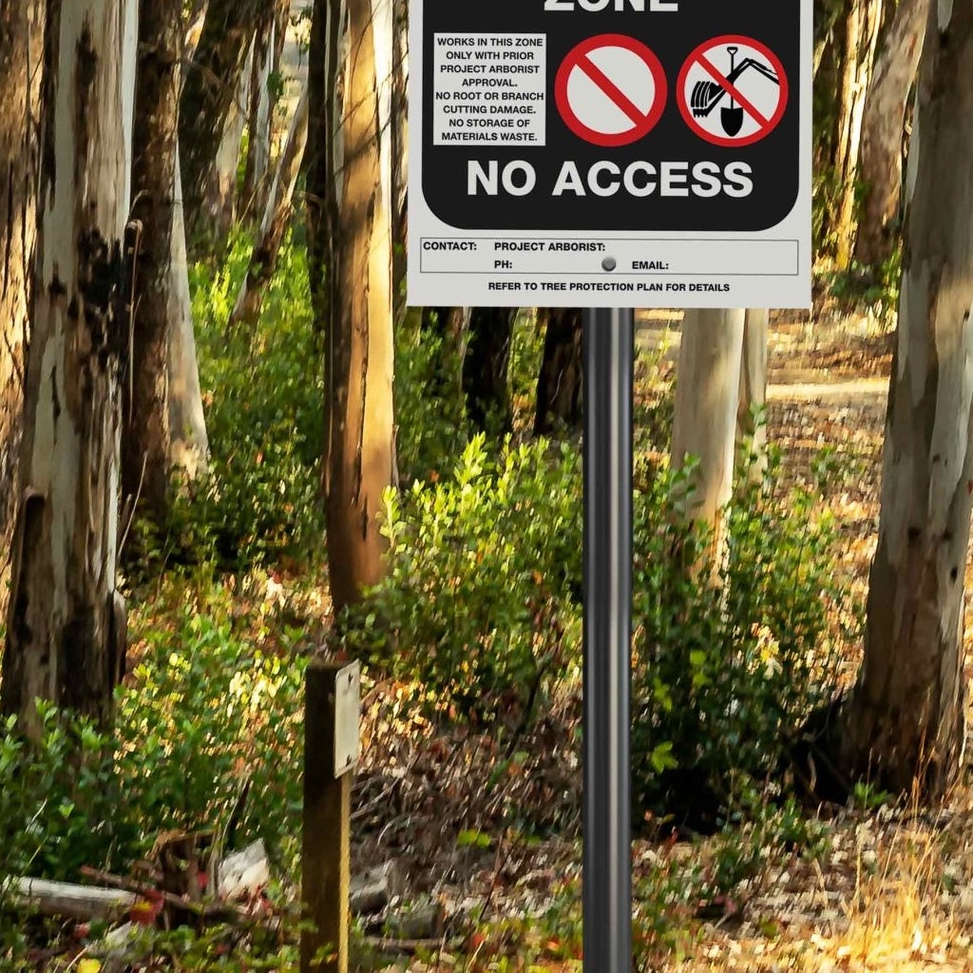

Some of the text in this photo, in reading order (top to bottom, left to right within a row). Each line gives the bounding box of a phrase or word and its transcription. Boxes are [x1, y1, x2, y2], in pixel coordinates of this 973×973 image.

[437, 38, 543, 46] WORKS IN THIS ZONE
[446, 51, 534, 60] ONLY WITH PRIOR
[440, 65, 540, 73] PROJECT ARBORIST
[462, 78, 517, 87] APPROVAL.
[436, 92, 544, 100] NO ROOT OR BRANCH
[443, 105, 536, 114] CUTTING DAMAGE.
[449, 119, 530, 127] NO STORAGE OF
[442, 132, 537, 141] MATERIALS WASTE.
[468, 160, 753, 197] NO ACCESS
[423, 242, 605, 251] CONTACT: PROJECT ARBORIST:
[494, 260, 669, 270] PH: EMAIL:
[488, 282, 521, 290] REFER
[524, 282, 538, 290] TO
[570, 283, 633, 291] PROTECTION
[637, 283, 663, 291] PLAN
[666, 283, 686, 291] FOR
[689, 284, 730, 292] DETAILS
